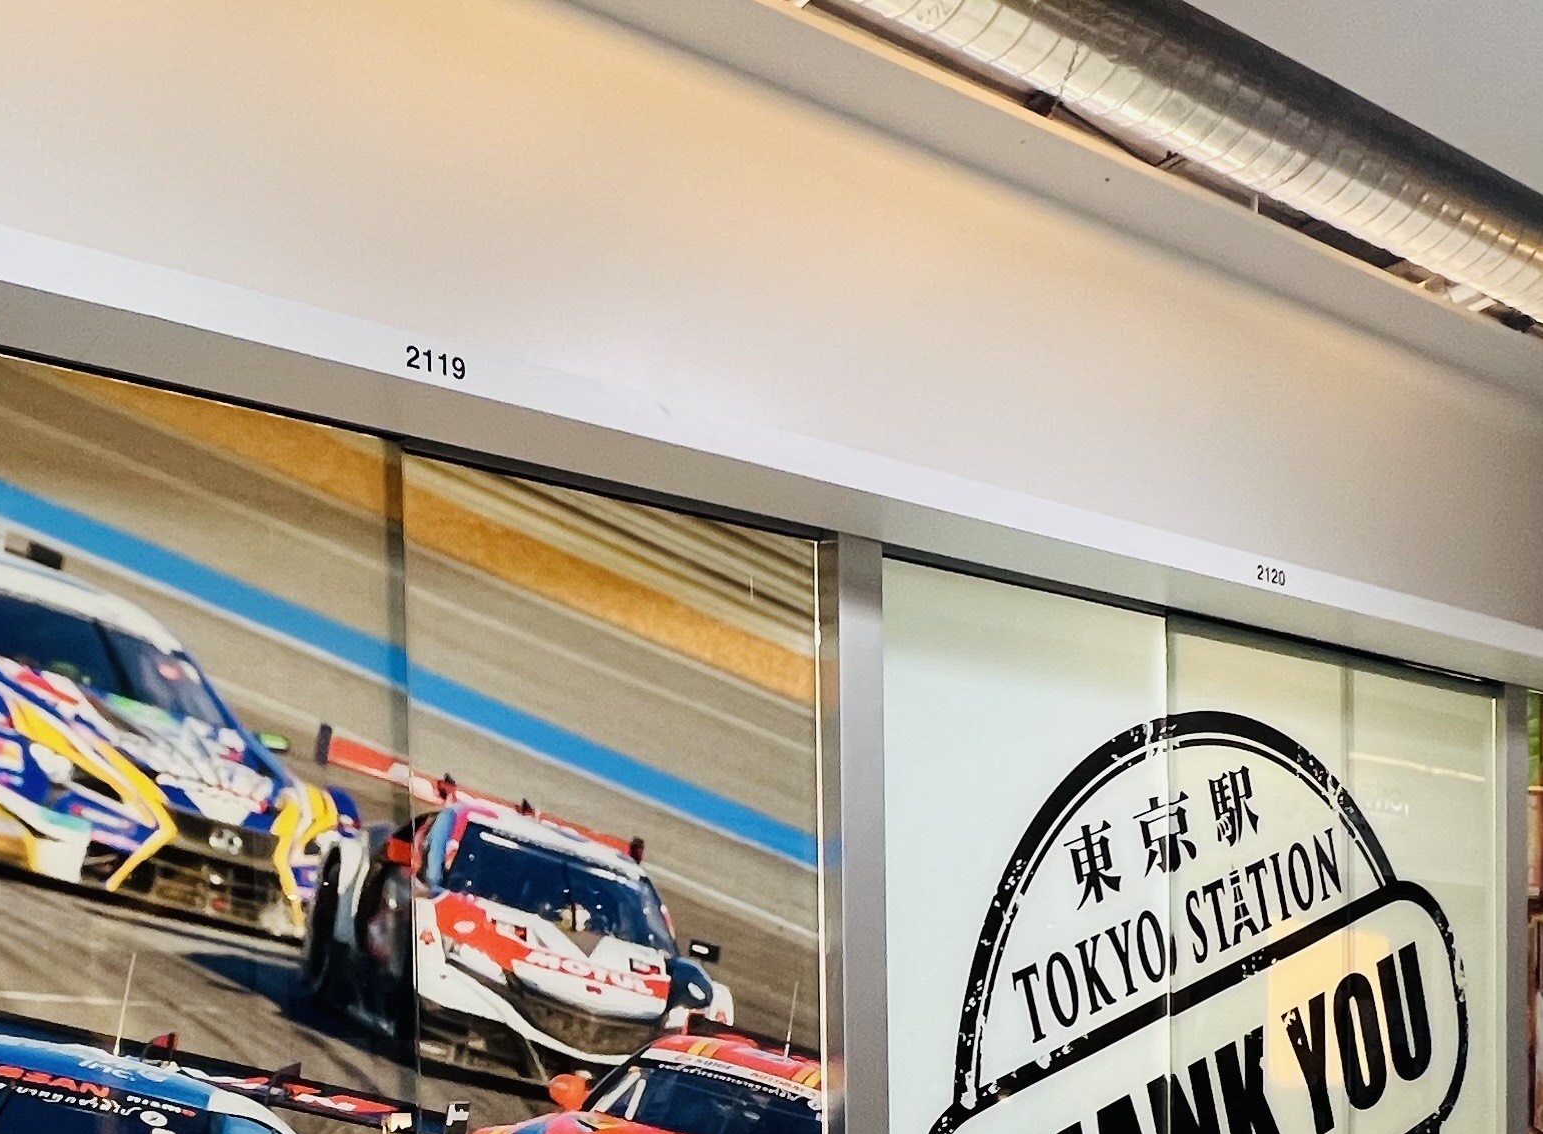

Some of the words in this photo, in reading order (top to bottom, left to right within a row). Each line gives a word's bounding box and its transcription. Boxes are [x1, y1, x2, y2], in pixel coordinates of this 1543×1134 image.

[406, 345, 466, 380] 2119
[1256, 564, 1286, 586] 2120
[1063, 765, 1259, 911] 東京駅
[1012, 910, 1176, 1043] TOKYO
[1185, 828, 1343, 963] STATION
